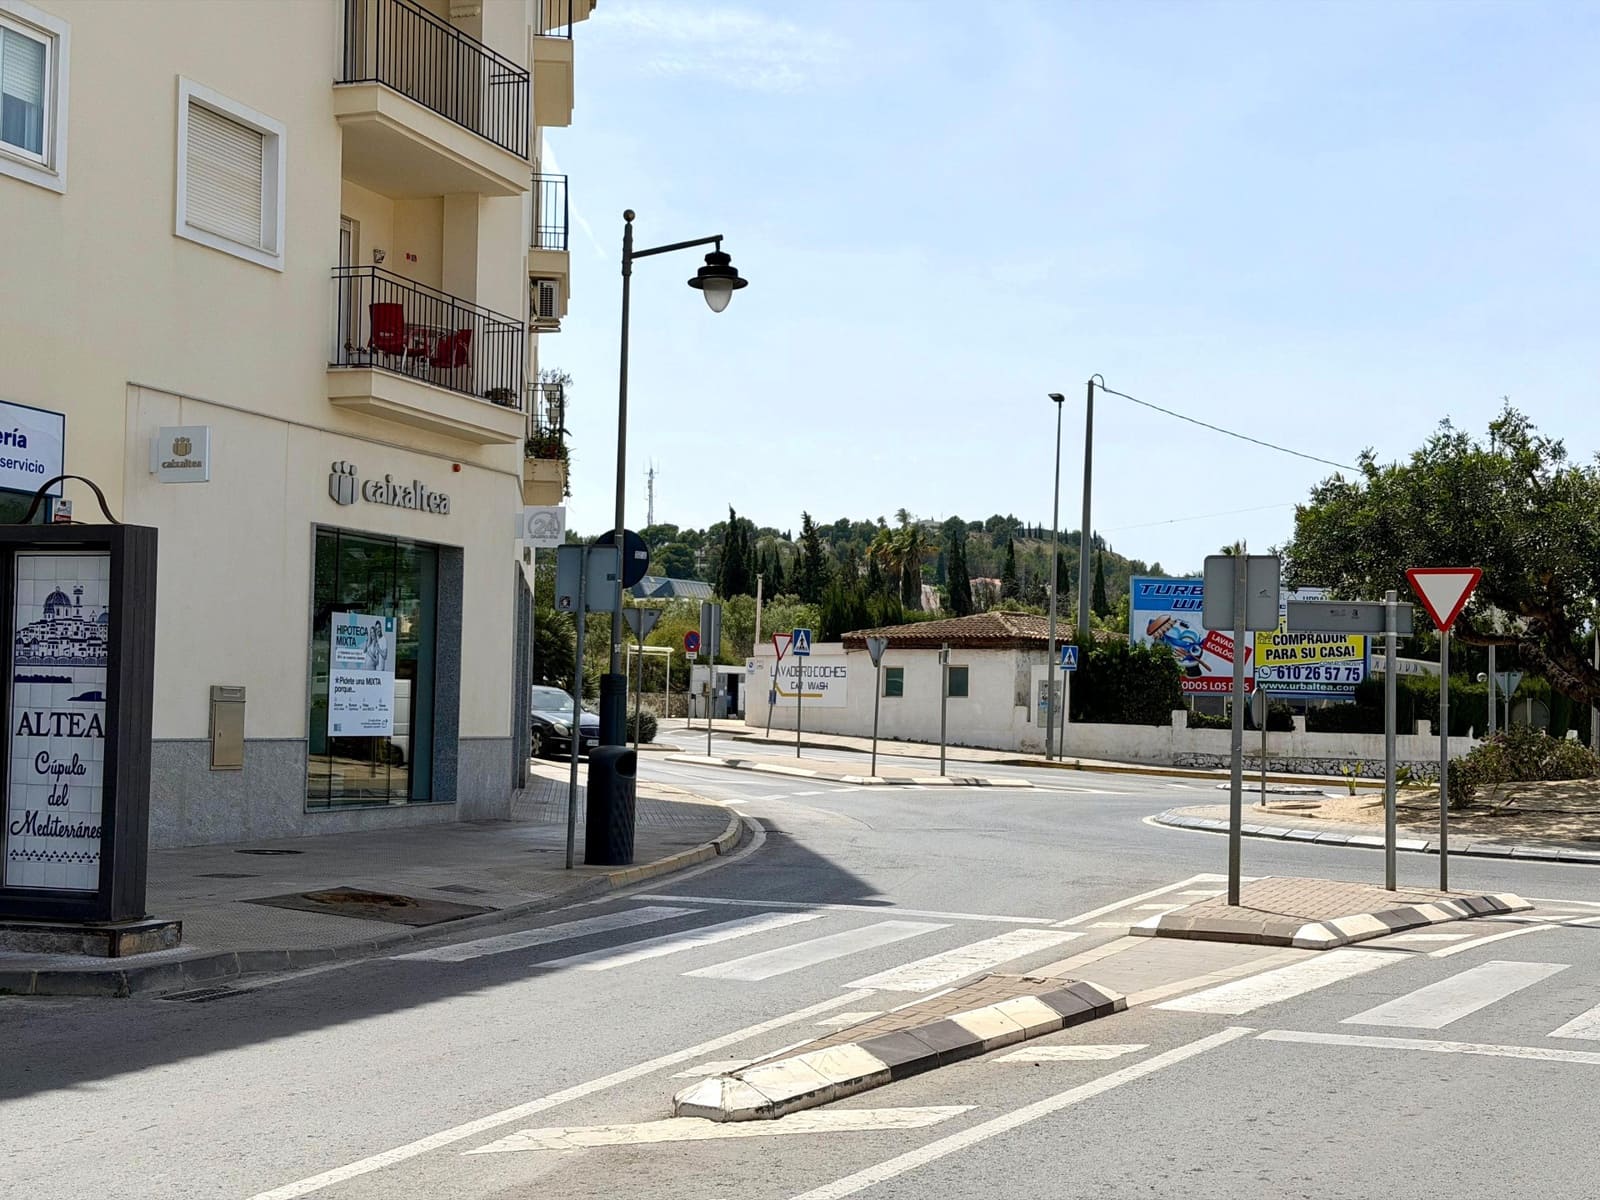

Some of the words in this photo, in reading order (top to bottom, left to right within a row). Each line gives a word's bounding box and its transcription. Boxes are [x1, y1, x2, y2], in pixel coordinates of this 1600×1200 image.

[0, 457, 45, 474] servicio
[362, 473, 450, 515] caixaltea
[1141, 583, 1204, 596] TURB
[336, 624, 369, 637] HIPOTECA
[336, 635, 357, 648] MIXTA
[1211, 633, 1235, 650] LAVAD
[1206, 641, 1235, 660] ECOLÓG
[1265, 648, 1297, 660] PARA
[1301, 647, 1316, 659] SU
[1319, 645, 1355, 658] CASA!
[813, 666, 847, 678] COCHES
[1276, 665, 1301, 680] 610
[1304, 666, 1321, 680] 26
[1324, 667, 1341, 681] 57
[1344, 667, 1361, 682] 75
[807, 681, 829, 690] WASH
[1209, 682, 1227, 692] LOS
[15, 711, 105, 738] ALTEA
[34, 750, 86, 783] Cúpula
[47, 783, 69, 807] del
